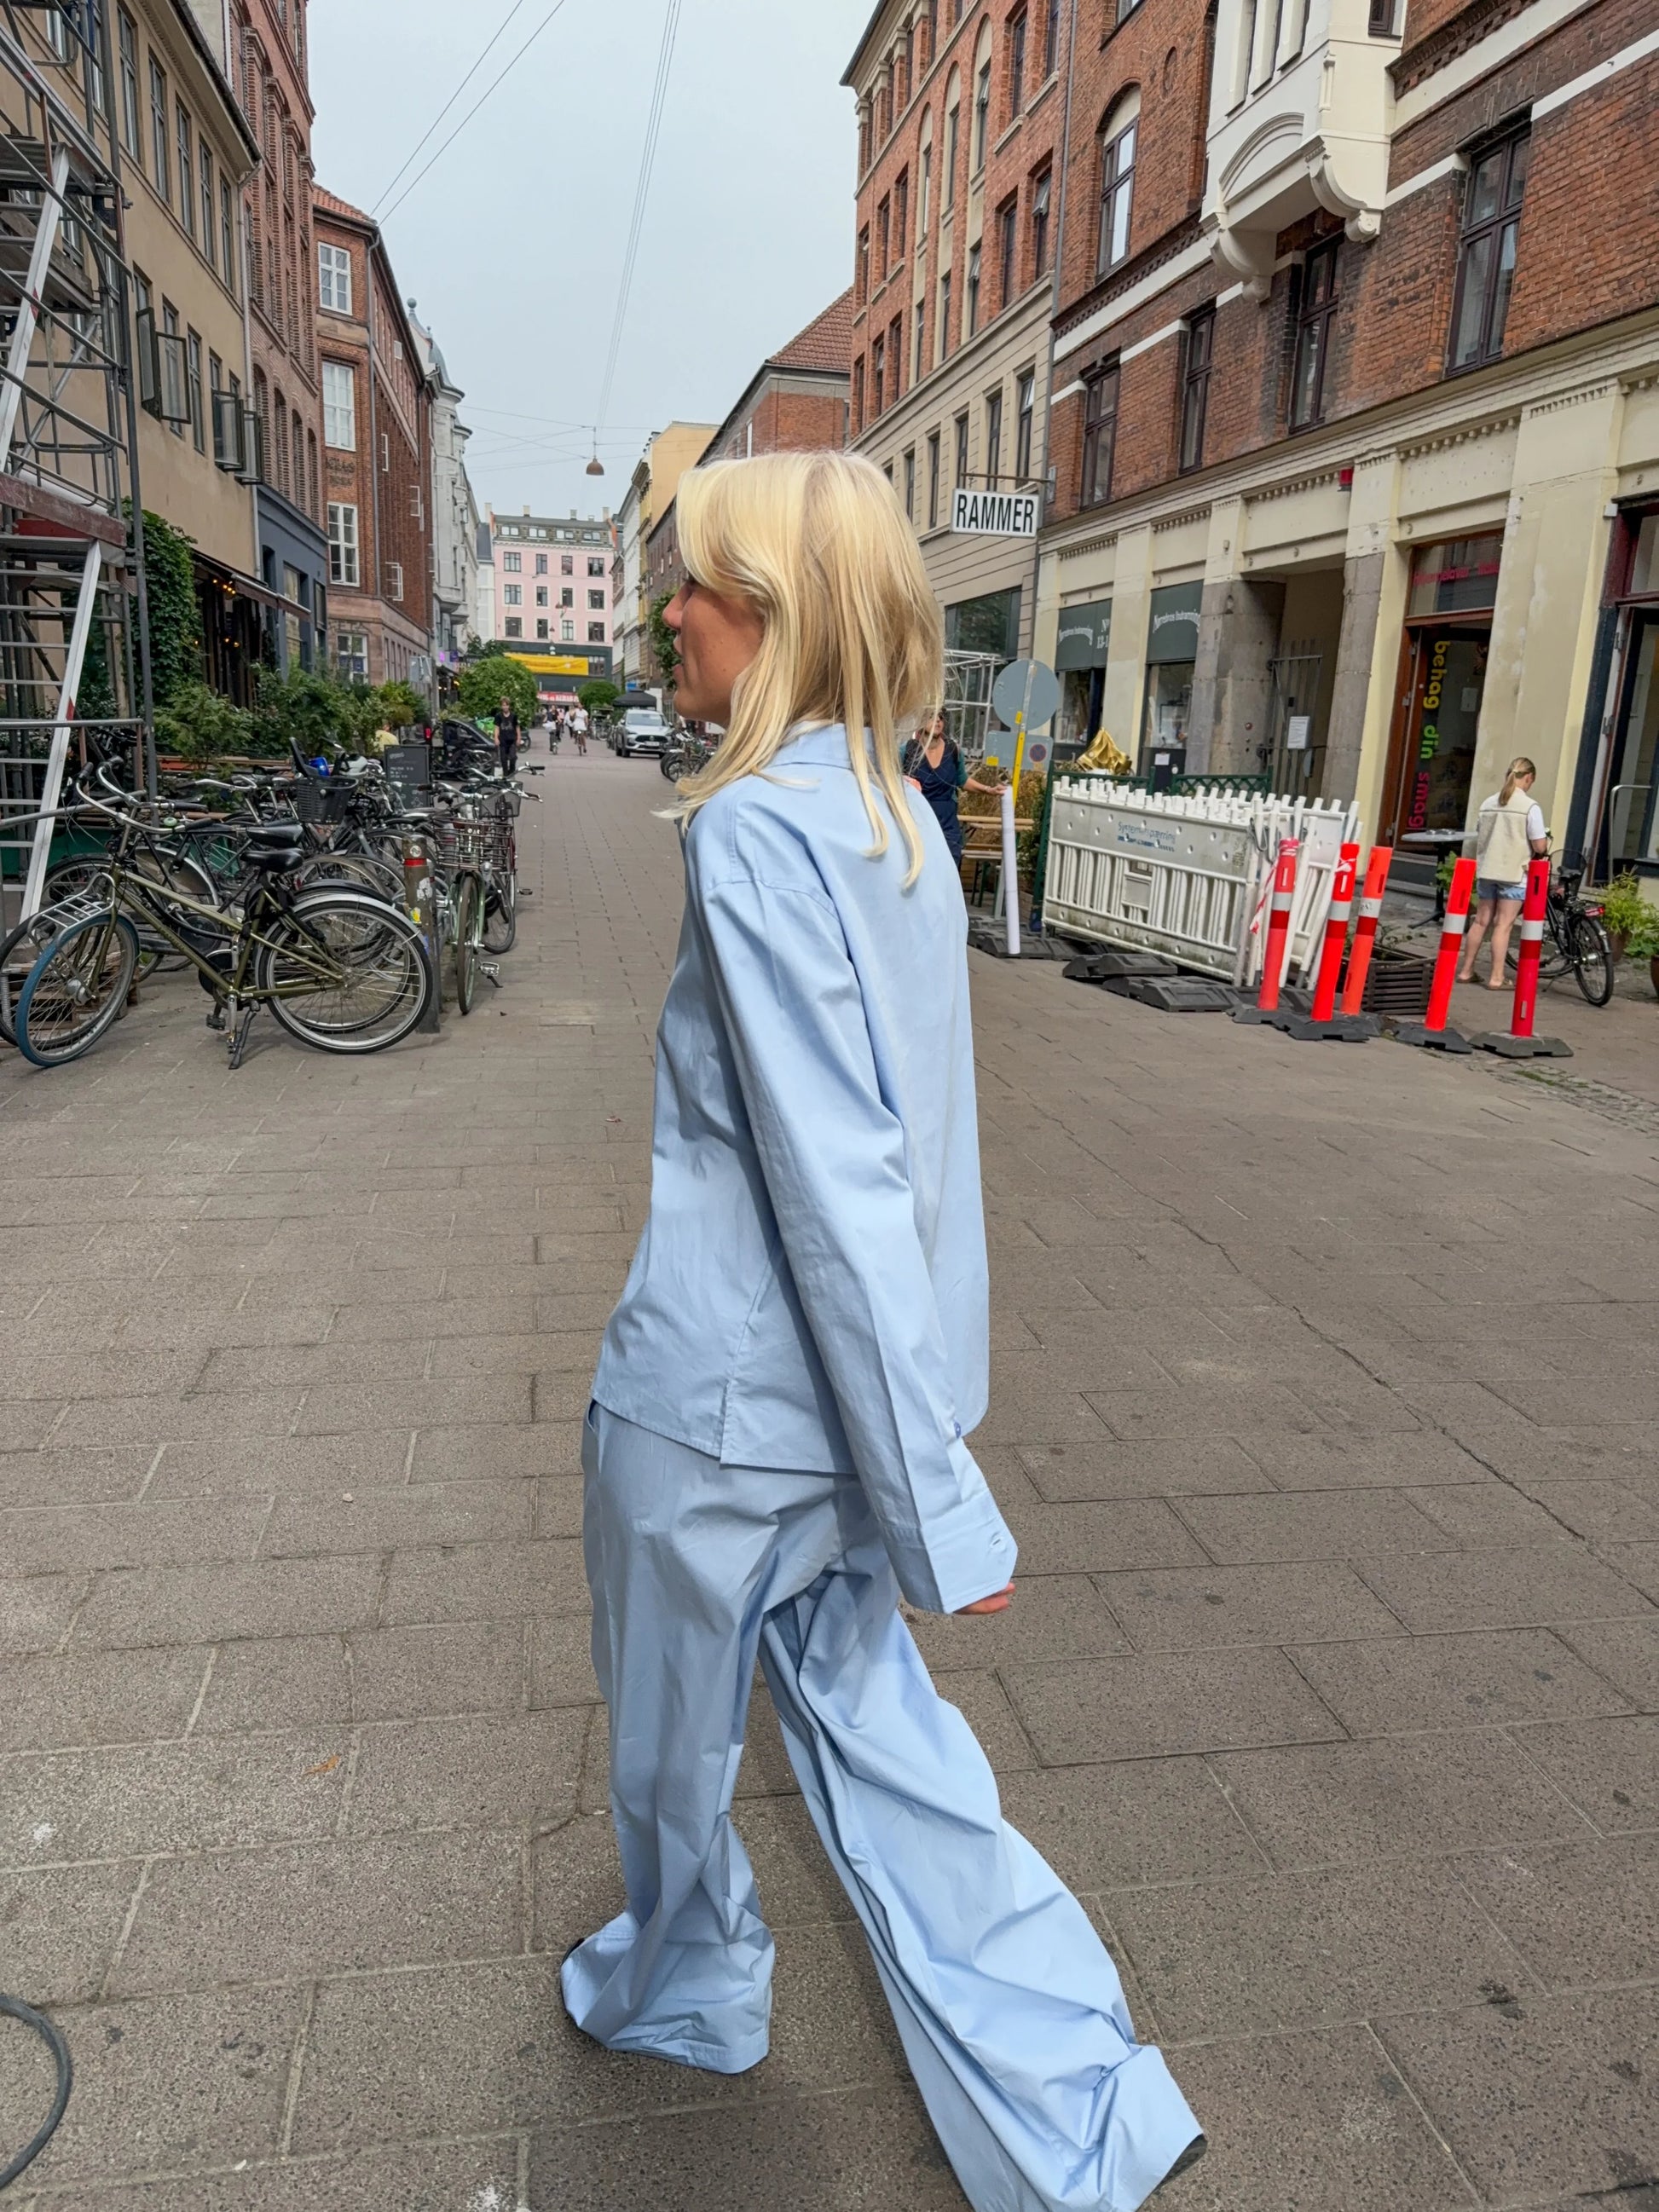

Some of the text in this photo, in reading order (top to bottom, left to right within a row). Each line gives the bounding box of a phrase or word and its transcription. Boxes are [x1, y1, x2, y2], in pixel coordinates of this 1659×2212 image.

[956, 494, 1034, 533] RAMMER
[1408, 640, 1451, 829] behag din smag
